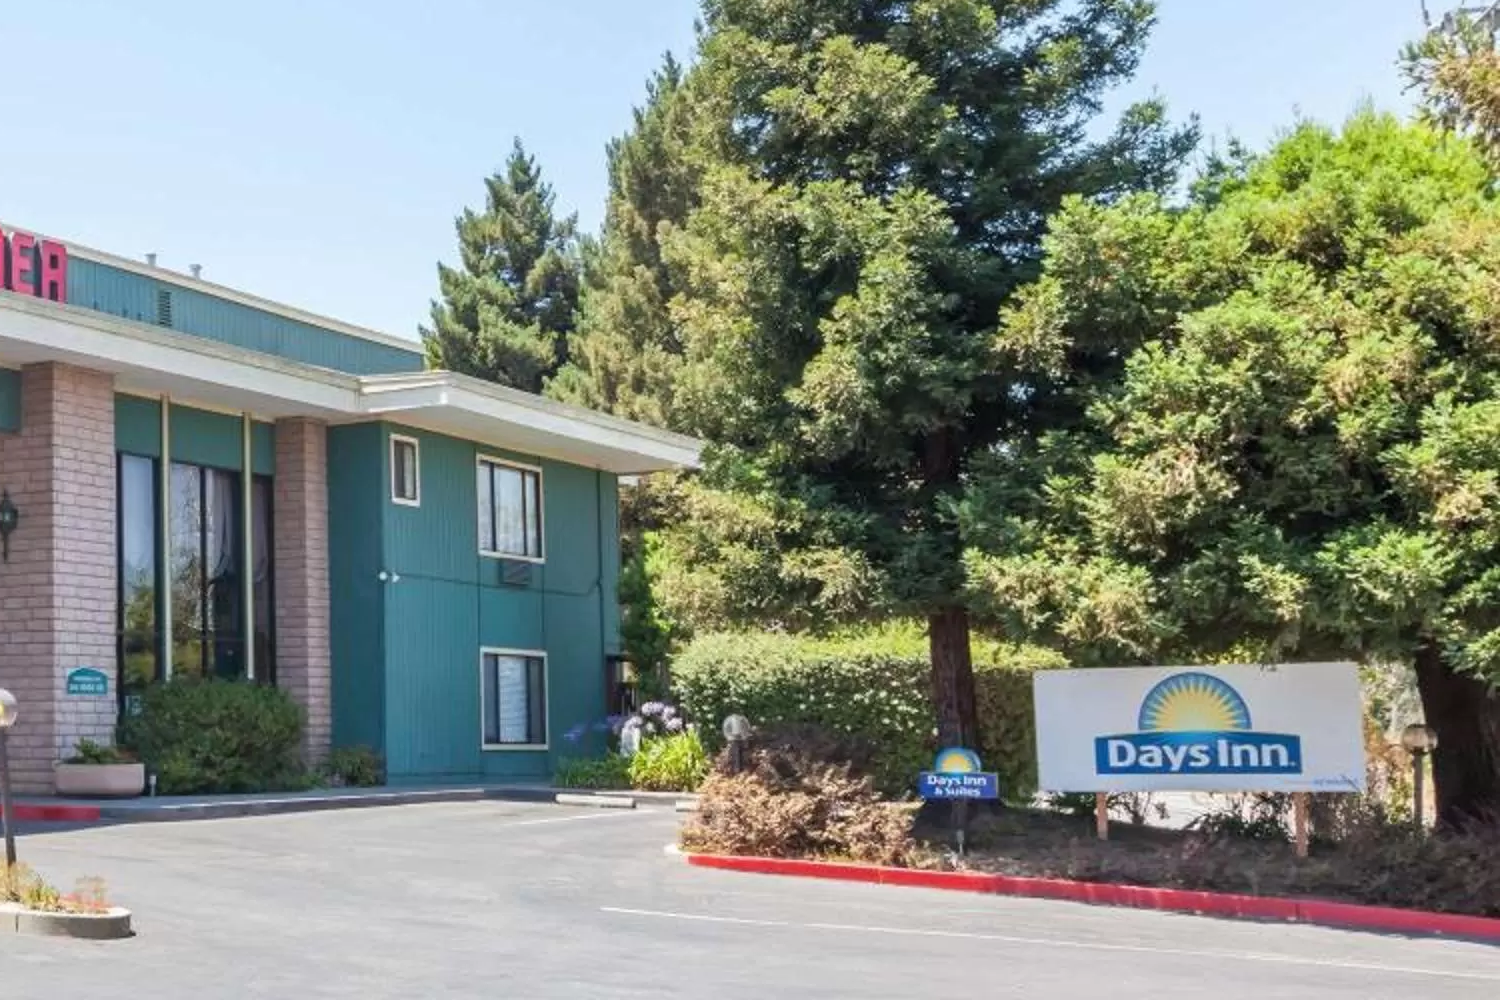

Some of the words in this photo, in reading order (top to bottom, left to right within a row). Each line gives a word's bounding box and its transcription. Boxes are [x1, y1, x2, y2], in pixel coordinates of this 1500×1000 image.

[1107, 738, 1211, 772] Days
[1217, 738, 1289, 768] Inn
[927, 775, 961, 788] Days
[963, 775, 987, 786] Inn
